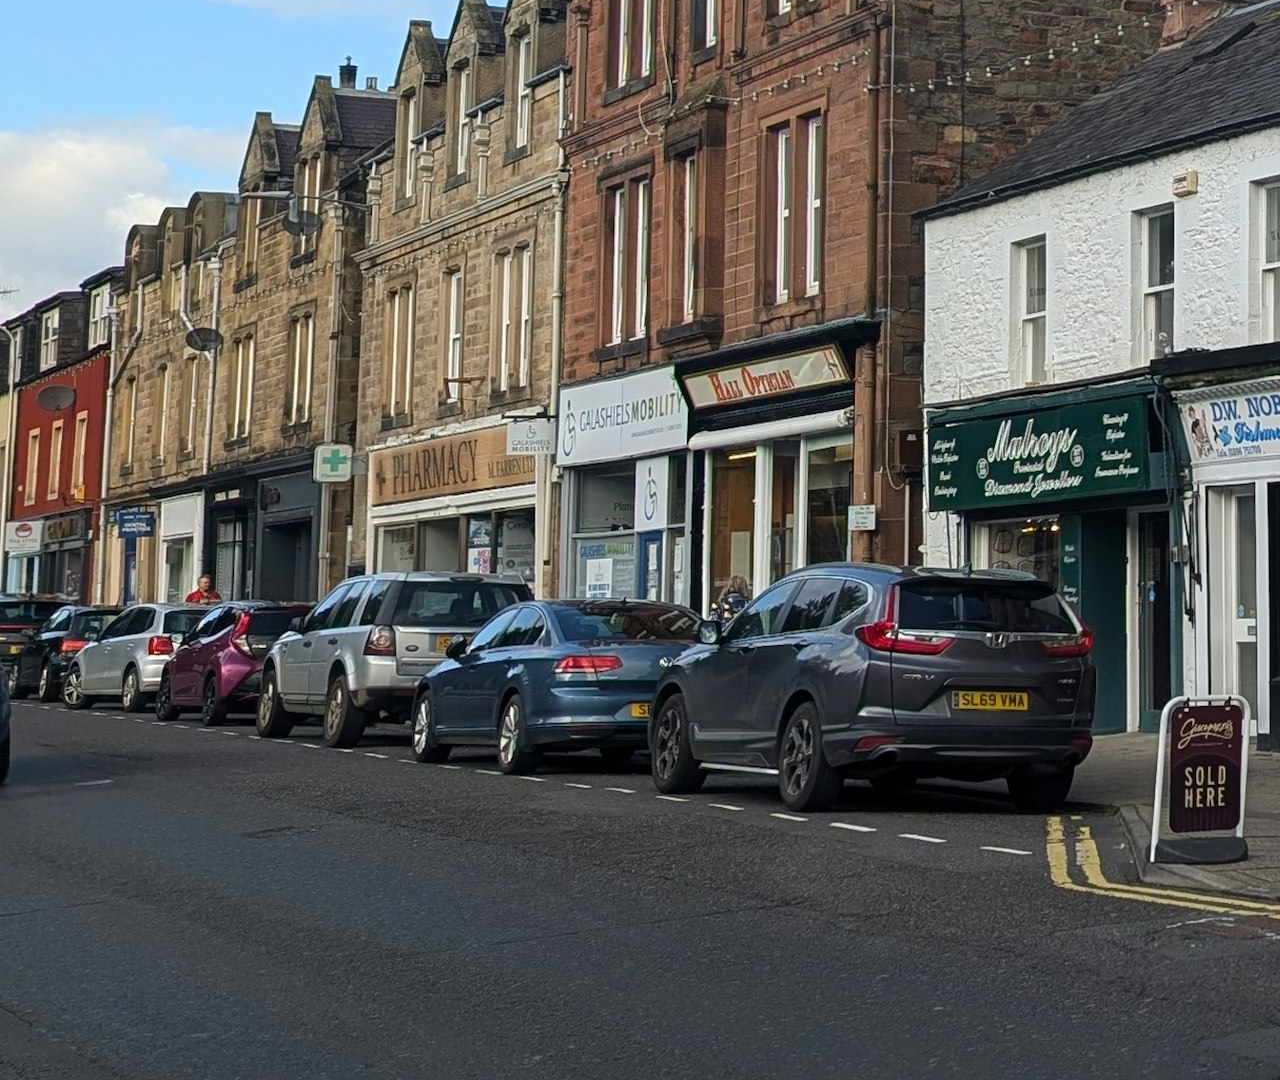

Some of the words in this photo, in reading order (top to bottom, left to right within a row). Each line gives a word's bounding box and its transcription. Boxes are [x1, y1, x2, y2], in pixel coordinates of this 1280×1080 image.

[1210, 398, 1242, 422] D.W.
[987, 418, 1077, 473] Malroys
[392, 438, 479, 496] PHARMACY
[984, 476, 1034, 498] Diamond
[962, 693, 999, 707] SL69
[1000, 694, 1025, 707] VMA
[1184, 765, 1227, 787] SOLD
[1184, 787, 1226, 809] HERE
